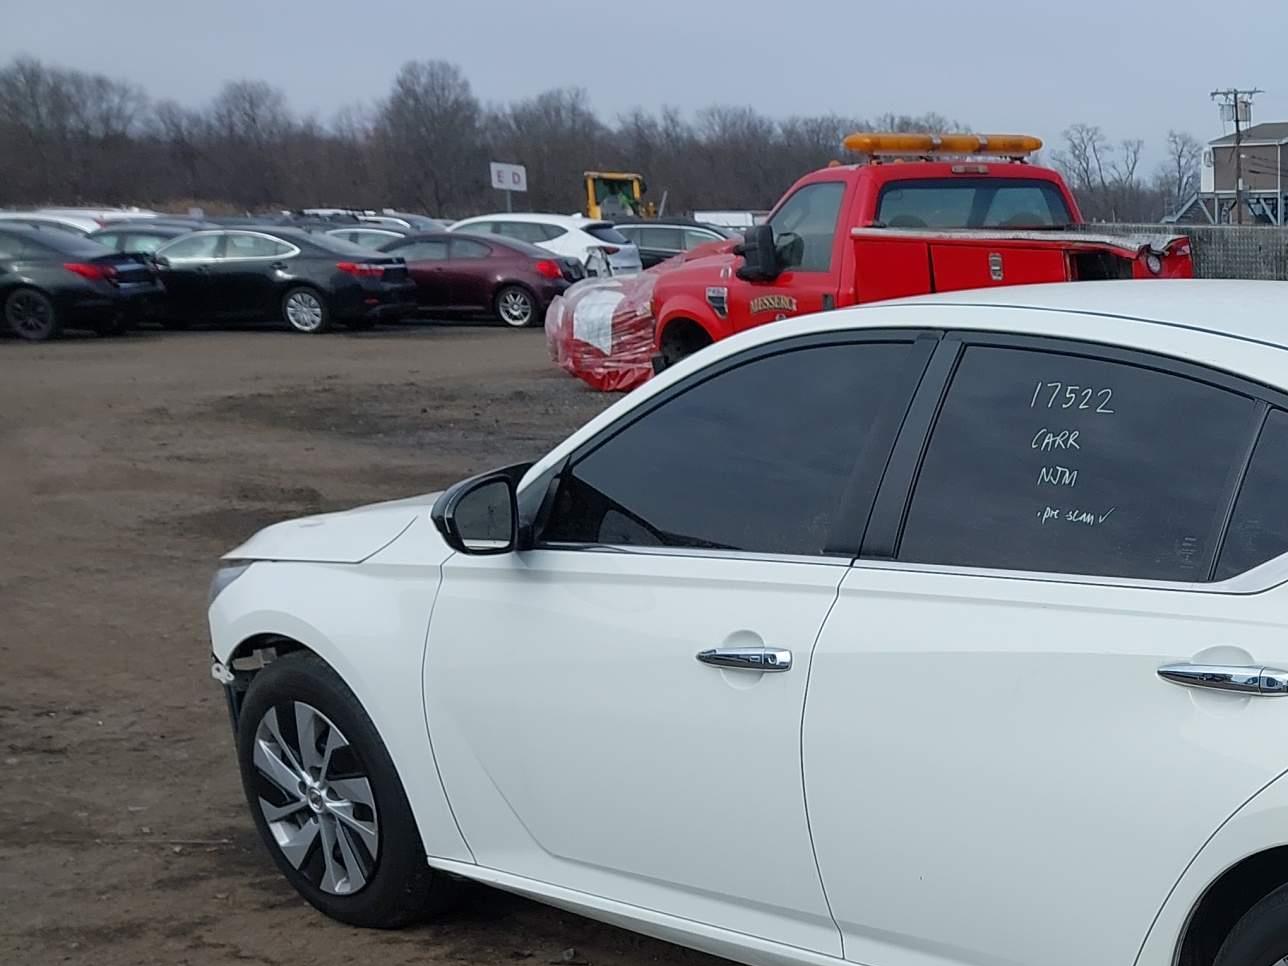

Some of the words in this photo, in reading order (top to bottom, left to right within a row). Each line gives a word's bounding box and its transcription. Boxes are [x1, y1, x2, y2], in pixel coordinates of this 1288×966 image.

[511, 171, 521, 185] D
[1030, 381, 1115, 414] 17522
[1031, 428, 1081, 451] CARR
